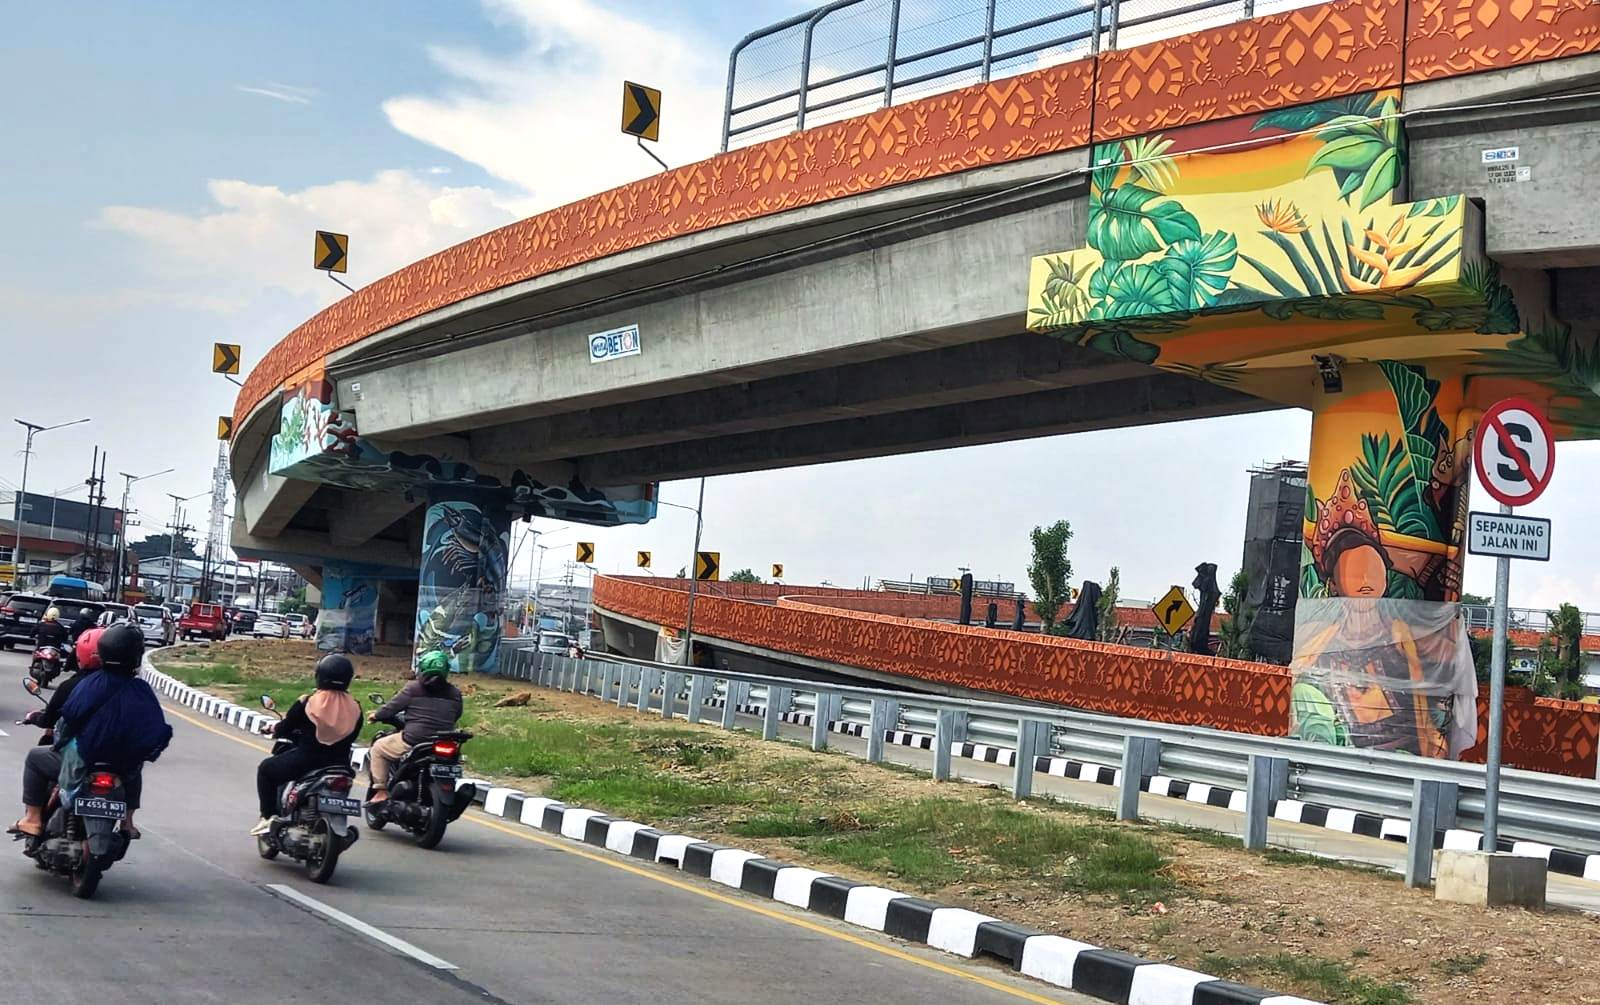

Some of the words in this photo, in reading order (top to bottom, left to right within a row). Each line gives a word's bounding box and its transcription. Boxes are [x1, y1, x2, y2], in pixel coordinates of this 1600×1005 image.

[608, 331, 638, 353] BETON
[1475, 520, 1544, 537] SEPANJANG
[1481, 535, 1518, 550] JALAN
[1521, 538, 1538, 552] INI
